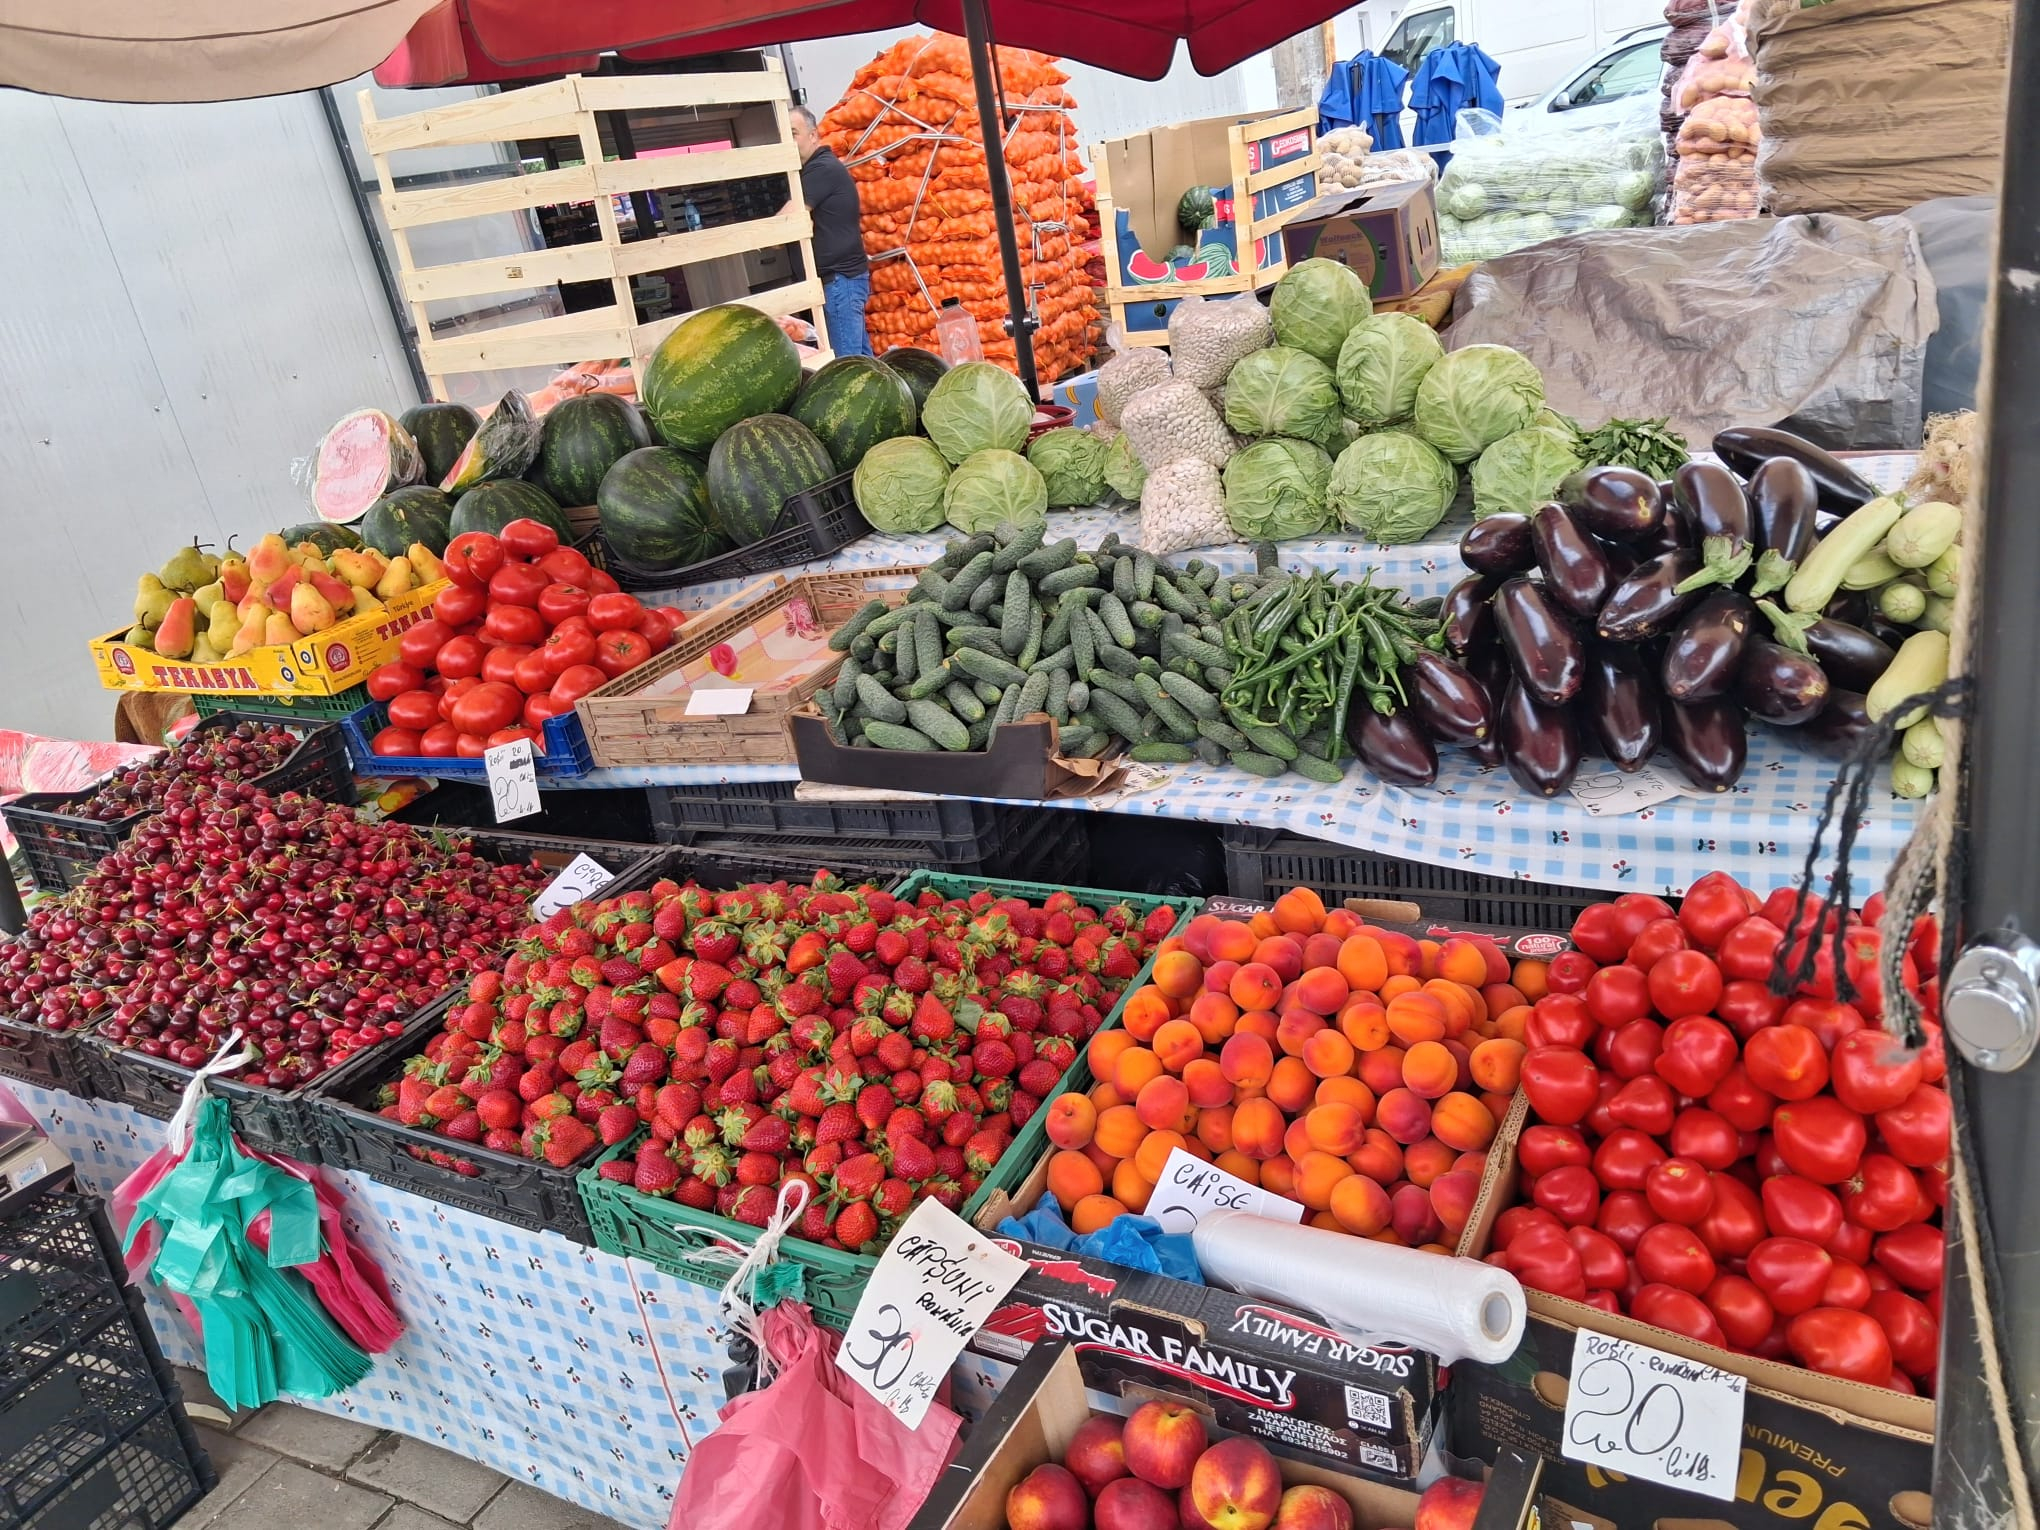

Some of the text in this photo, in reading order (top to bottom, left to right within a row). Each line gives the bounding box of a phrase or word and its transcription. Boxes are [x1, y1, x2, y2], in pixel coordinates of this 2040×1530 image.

[152, 665, 259, 689] TEKASYA
[1208, 901, 1265, 914] SUGAR
[1521, 941, 1557, 950] natural
[846, 1303, 914, 1390] 30
[1042, 1303, 1162, 1363] SUGAR
[1162, 1335, 1297, 1401] FAMILY
[1228, 1310, 1415, 1377] SUGAR FAMILY
[1478, 1399, 1513, 1419] POLAND
[1570, 1358, 1684, 1455] 20
[1264, 1423, 1332, 1448] ΙΕΡΑΠΕΤΡΑ
[1360, 1440, 1390, 1453] CLASS
